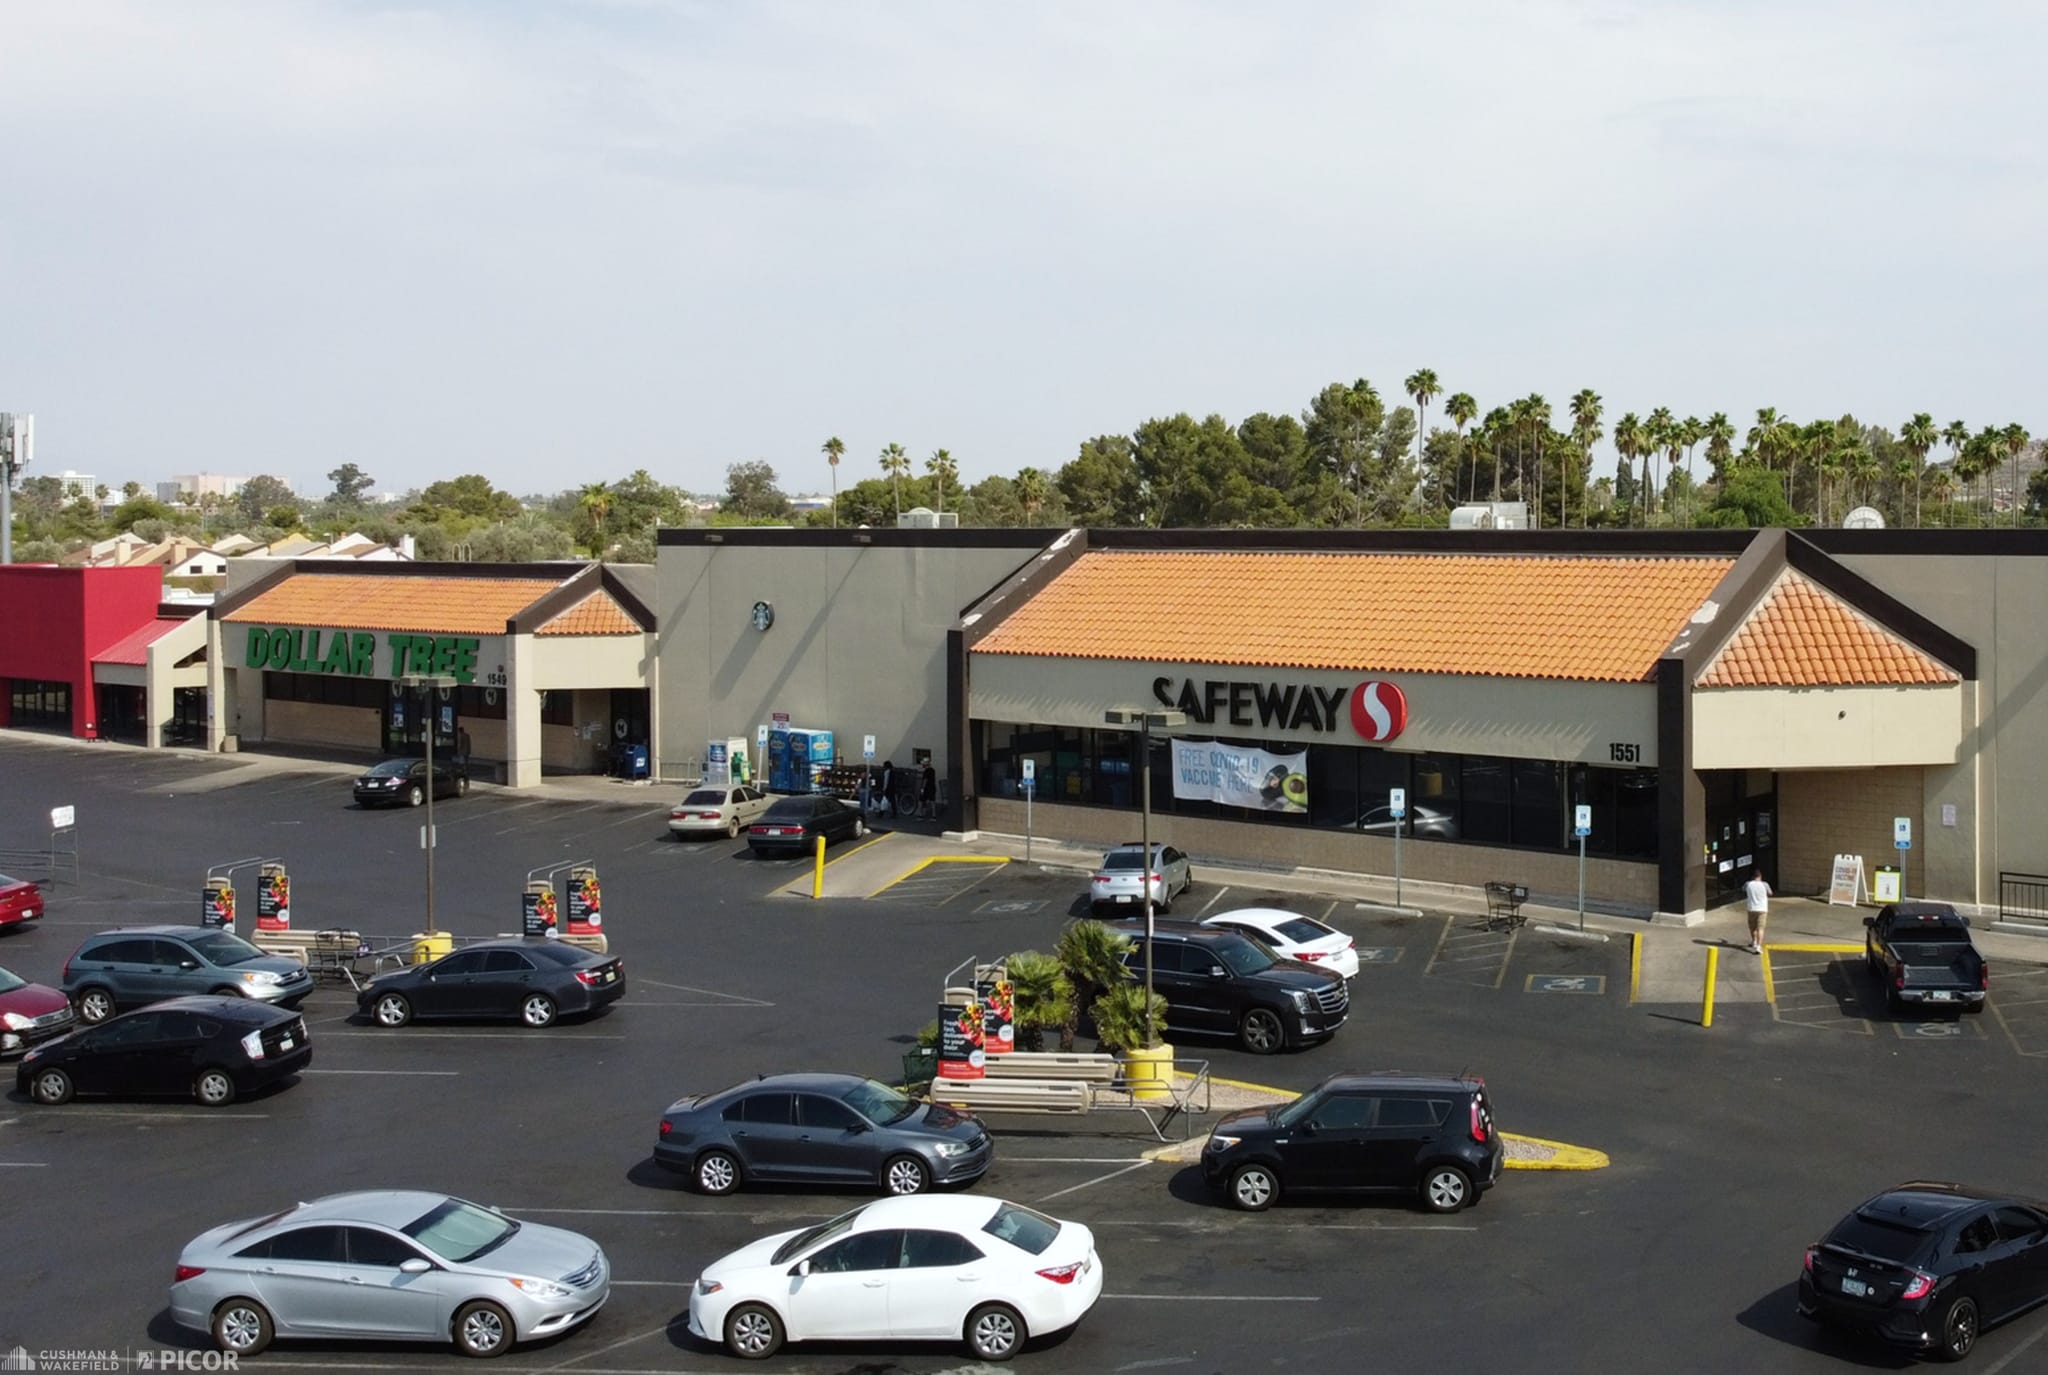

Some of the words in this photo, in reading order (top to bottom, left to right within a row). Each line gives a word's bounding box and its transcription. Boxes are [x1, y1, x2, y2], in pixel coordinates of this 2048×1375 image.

[246, 627, 375, 677] DOLLAR
[388, 634, 480, 684] TREE
[1152, 676, 1348, 732] SAFEWAY
[1179, 748, 1205, 768] FREE
[1609, 743, 1640, 762] 1551
